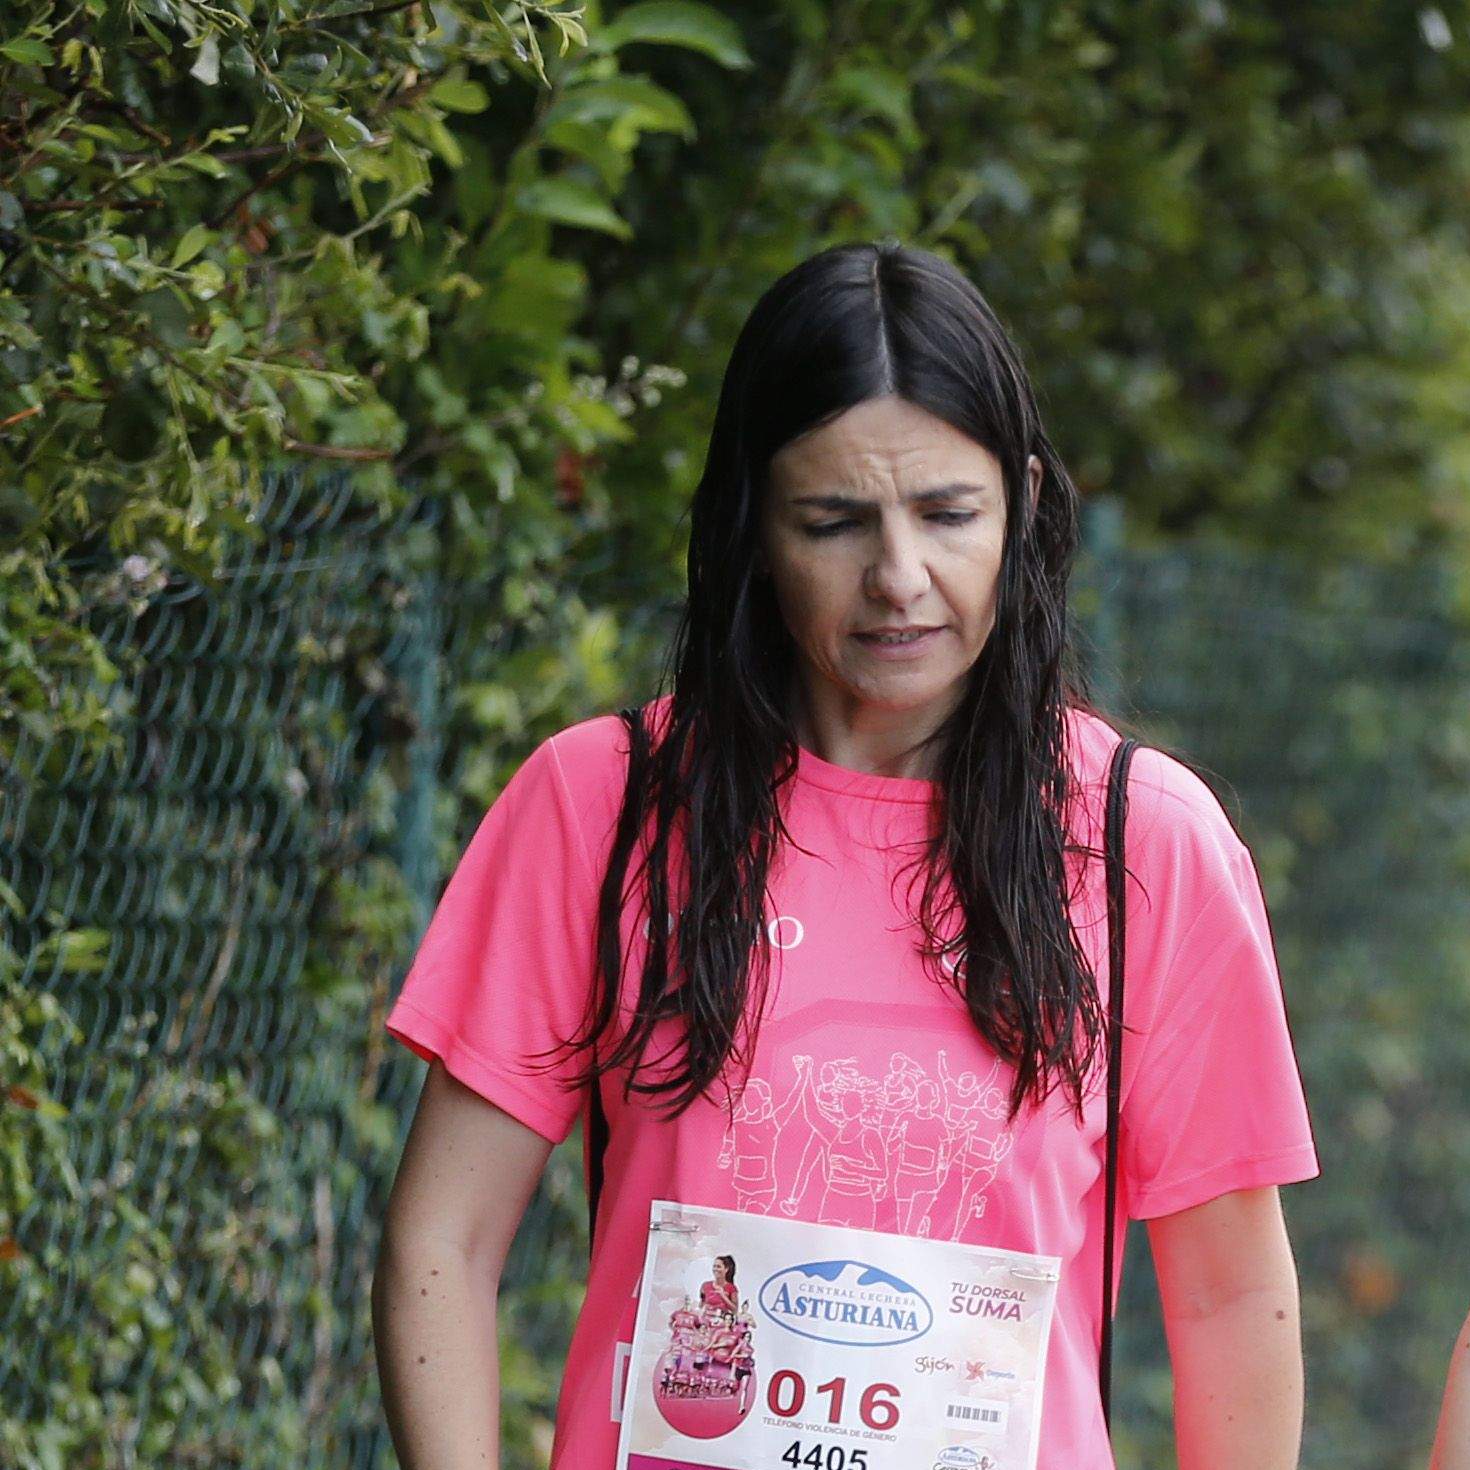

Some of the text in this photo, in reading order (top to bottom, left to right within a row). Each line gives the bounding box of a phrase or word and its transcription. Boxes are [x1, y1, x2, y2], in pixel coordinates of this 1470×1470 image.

[798, 1283, 917, 1307] CENTRAL LECHERA
[951, 1282, 1026, 1302] TU DORSAL
[770, 1282, 919, 1333] ASTURIANA
[949, 1295, 1023, 1322] SUMA
[767, 1369, 901, 1431] 016
